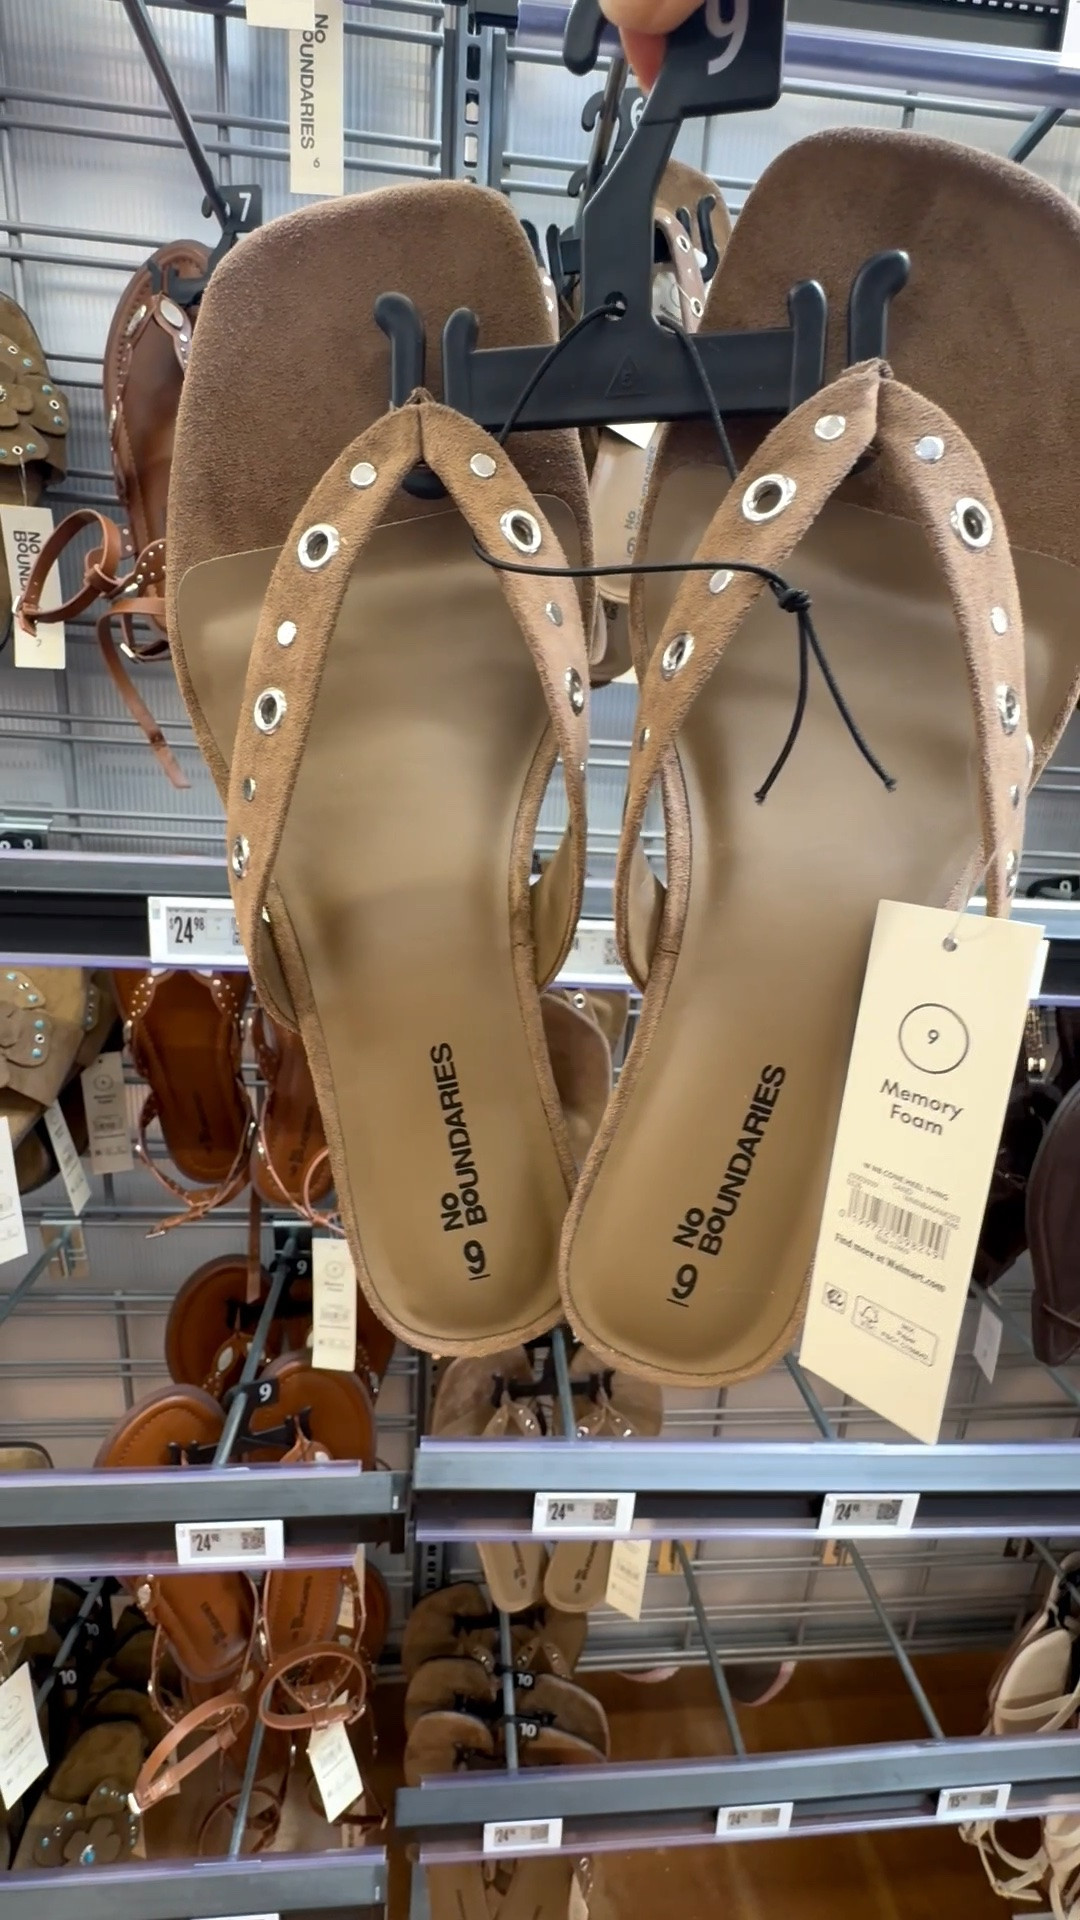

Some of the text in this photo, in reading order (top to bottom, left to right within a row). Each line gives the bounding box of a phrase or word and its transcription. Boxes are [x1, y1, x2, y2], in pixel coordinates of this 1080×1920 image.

[314, 13, 329, 44] NO
[704, 0, 749, 76] 9
[299, 29, 315, 150] OUNDARIES
[313, 157, 321, 169] 6
[238, 192, 252, 222] 7
[27, 531, 42, 555] NO
[927, 1028, 940, 1045] 9
[879, 1078, 964, 1122] Memory
[430, 1042, 488, 1226] BOUNDARIES
[890, 1103, 943, 1136] Foam
[698, 1064, 787, 1256] BOUNDARIES
[296, 1259, 308, 1275] 9
[834, 1232, 853, 1249] Find
[853, 1242, 875, 1260] more
[875, 1254, 886, 1265] at
[886, 1258, 947, 1293] Walmart.com
[258, 1382, 273, 1403] 9
[59, 1669, 77, 1686] 10
[517, 1673, 534, 1687] 10
[519, 1722, 537, 1738] 10
